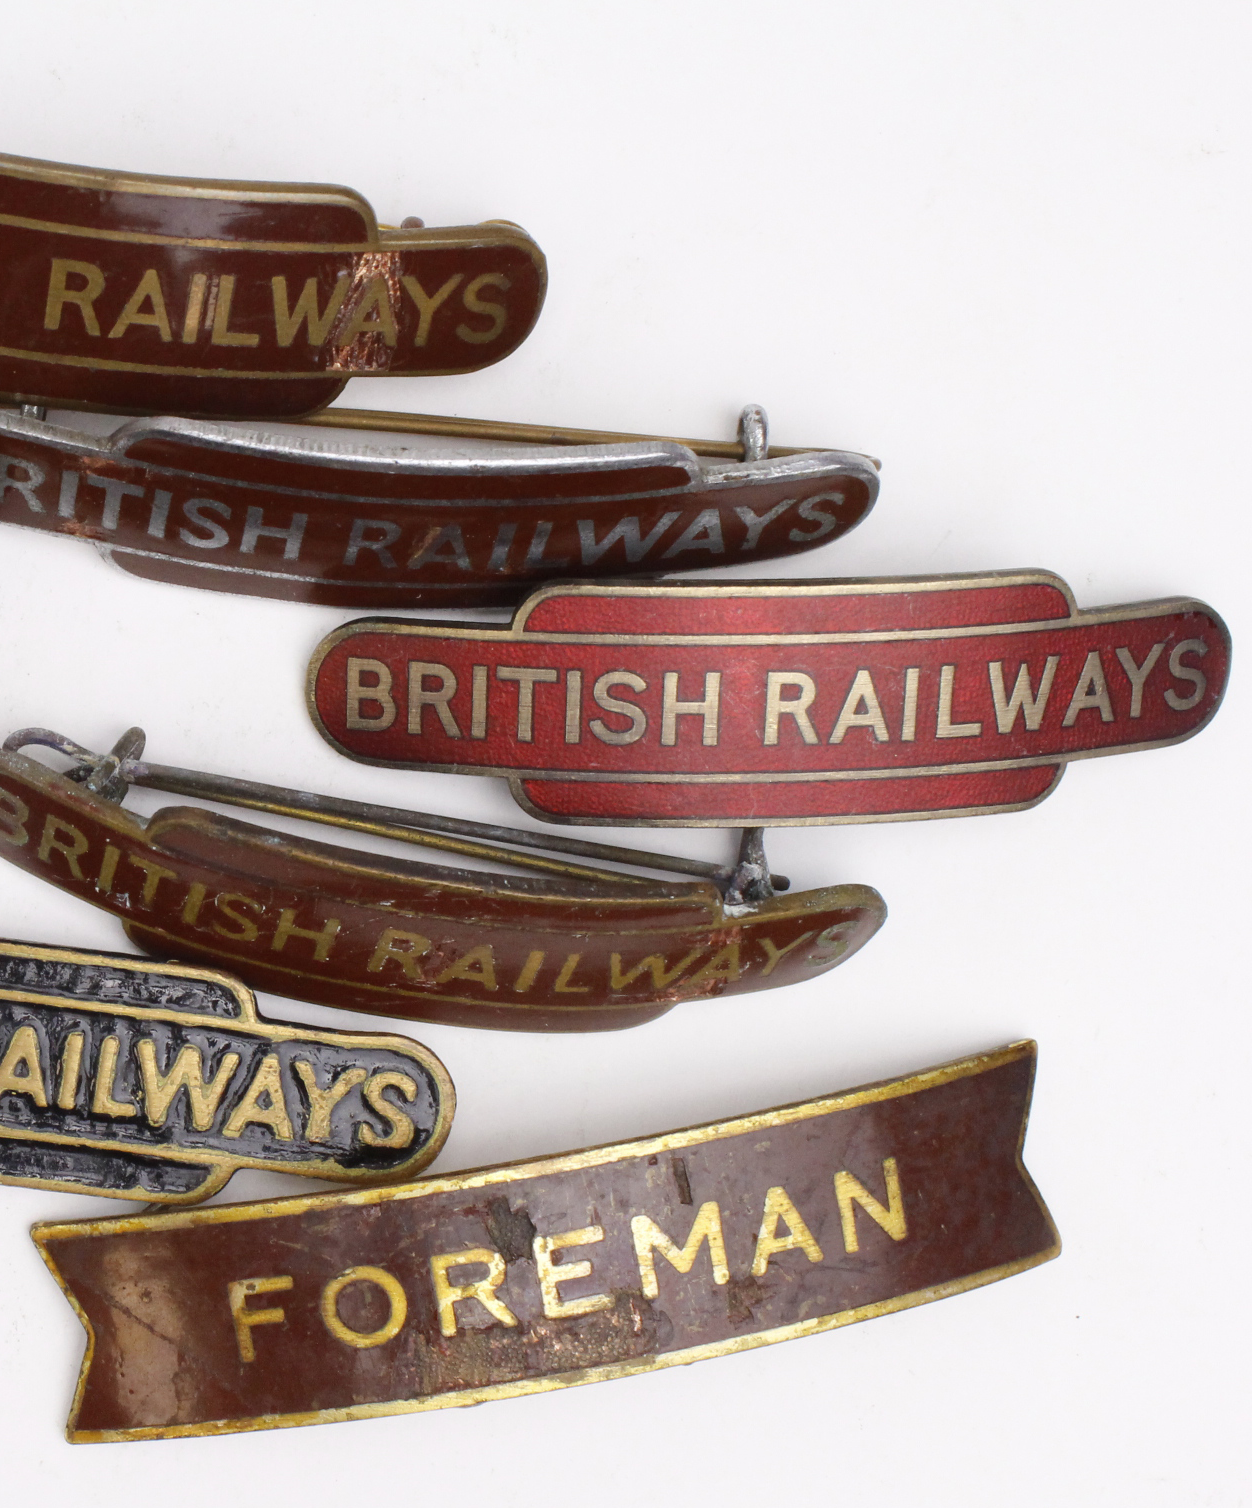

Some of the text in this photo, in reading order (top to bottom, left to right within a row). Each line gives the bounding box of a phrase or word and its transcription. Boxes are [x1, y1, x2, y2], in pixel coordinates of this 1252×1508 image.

[44, 258, 510, 348] RAILWAYS
[345, 491, 844, 572] RAILWAYS
[347, 639, 1208, 747] BRITISH RAILWAYS
[368, 919, 860, 998] RAILWAYS
[229, 1157, 909, 1361] FOREMAN
